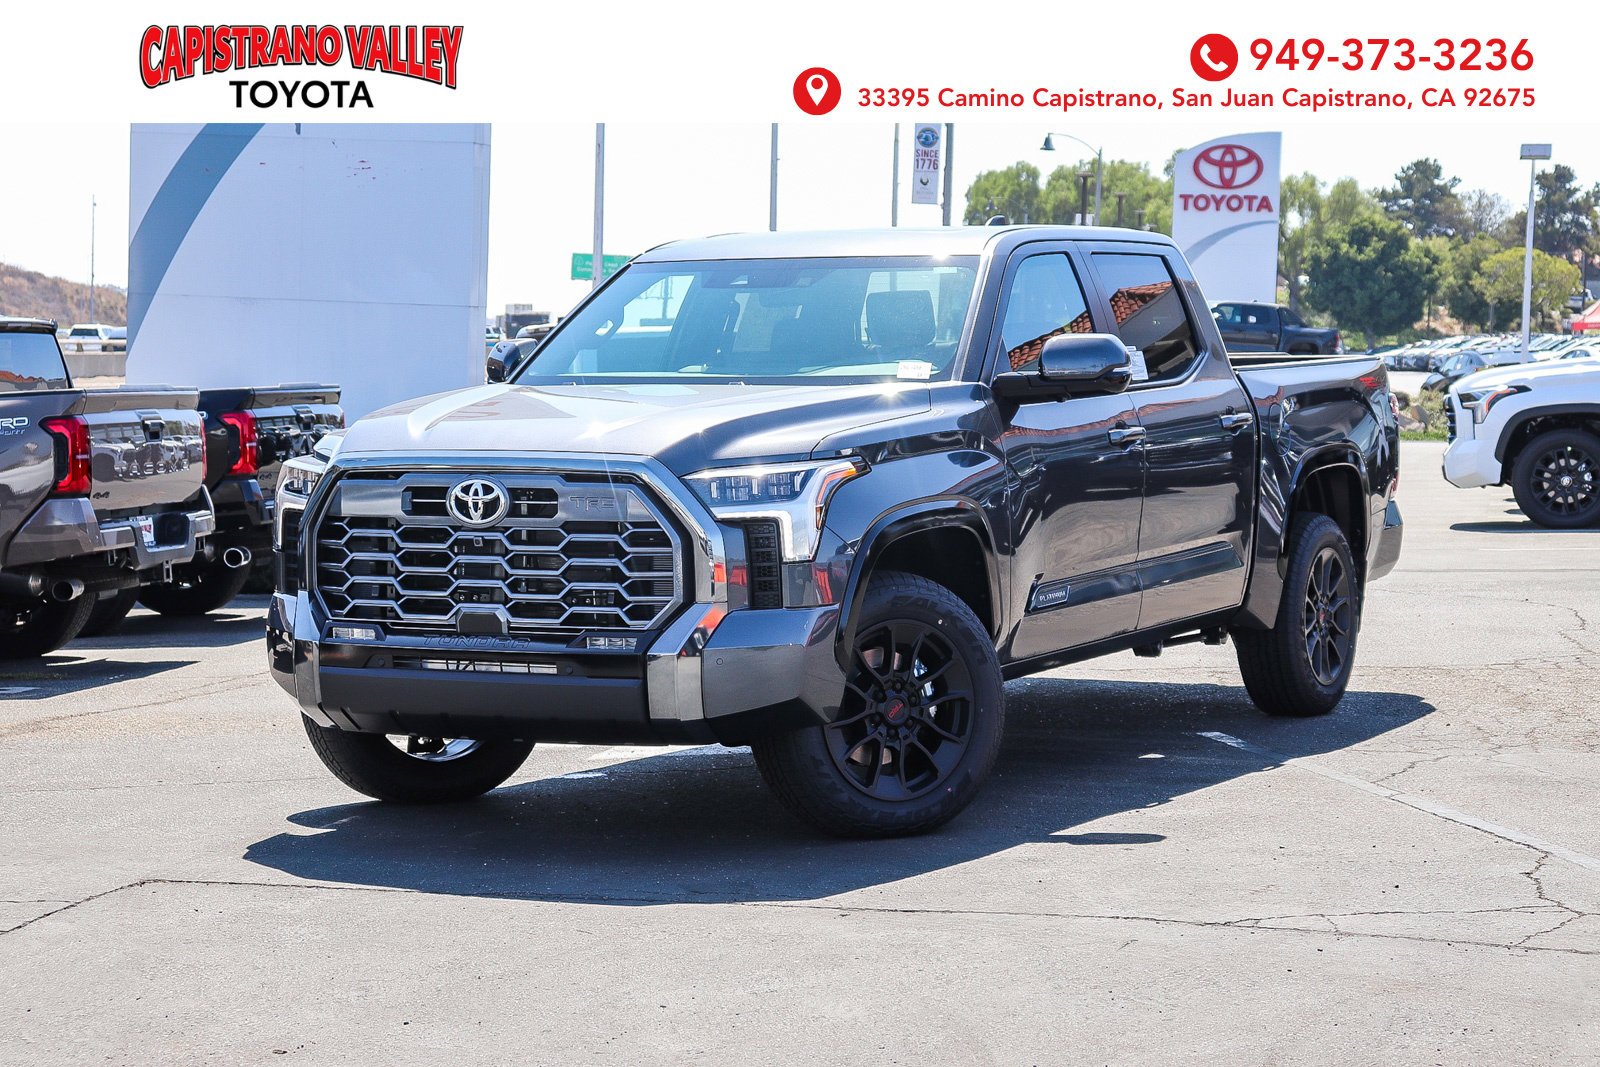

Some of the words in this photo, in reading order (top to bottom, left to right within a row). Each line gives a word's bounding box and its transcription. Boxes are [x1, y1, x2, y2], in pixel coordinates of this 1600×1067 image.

[916, 149, 939, 158] SINCE
[916, 160, 939, 170] 1776
[1180, 194, 1273, 212] TOYOTA
[0, 417, 28, 430] RD
[1040, 591, 1066, 601] PLATINUM
[424, 634, 531, 649] TUNDRA
